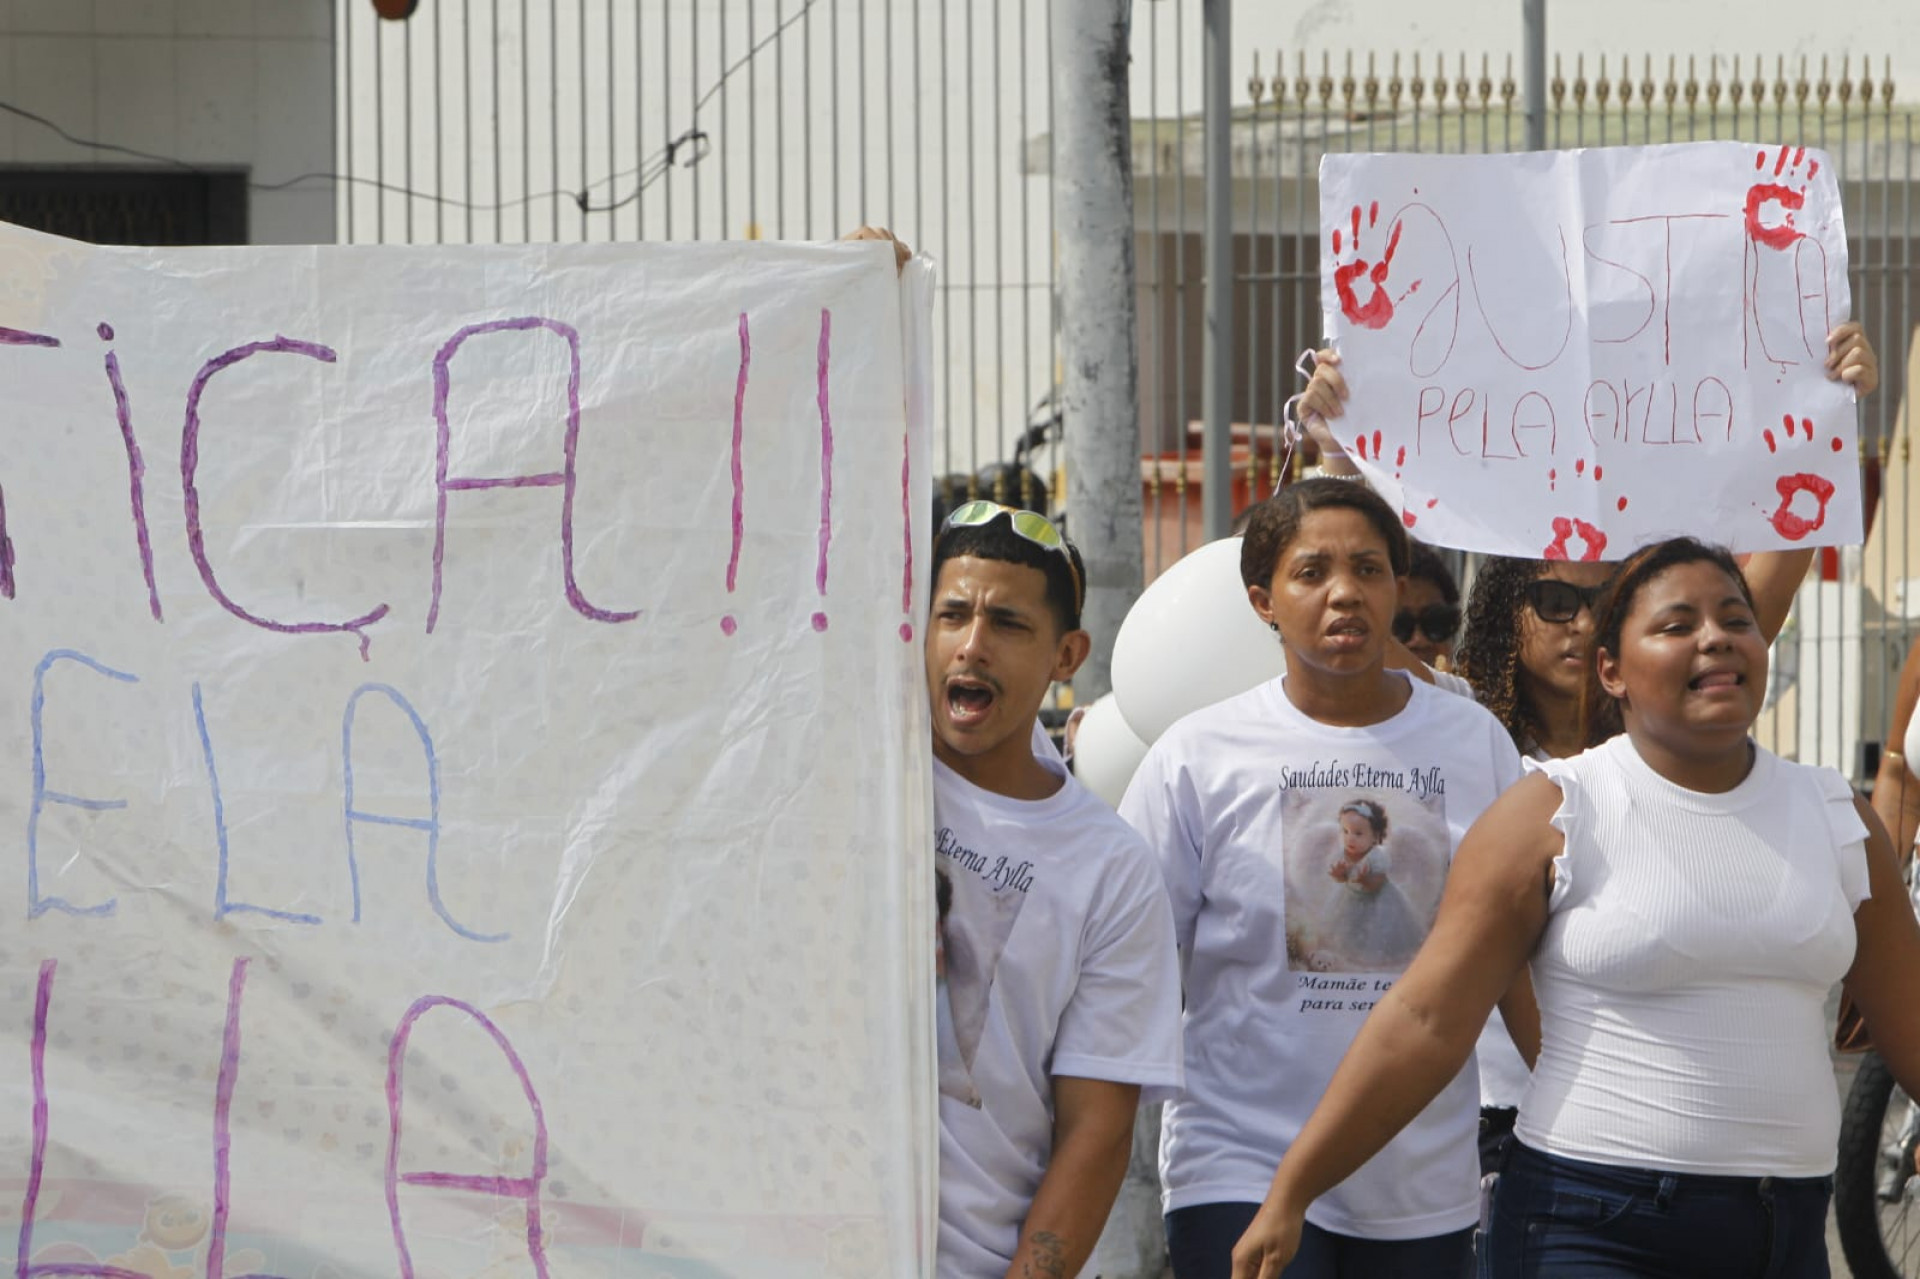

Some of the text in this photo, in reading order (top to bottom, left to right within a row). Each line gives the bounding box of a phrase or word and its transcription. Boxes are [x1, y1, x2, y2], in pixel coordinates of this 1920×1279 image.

[1584, 376, 1733, 446] AYLLA
[1279, 760, 1446, 800] Saudades Eterna Aylla
[936, 827, 1035, 893] Eterna Aylla
[1299, 975, 1392, 991] Mamãe te
[1299, 999, 1343, 1013] para
